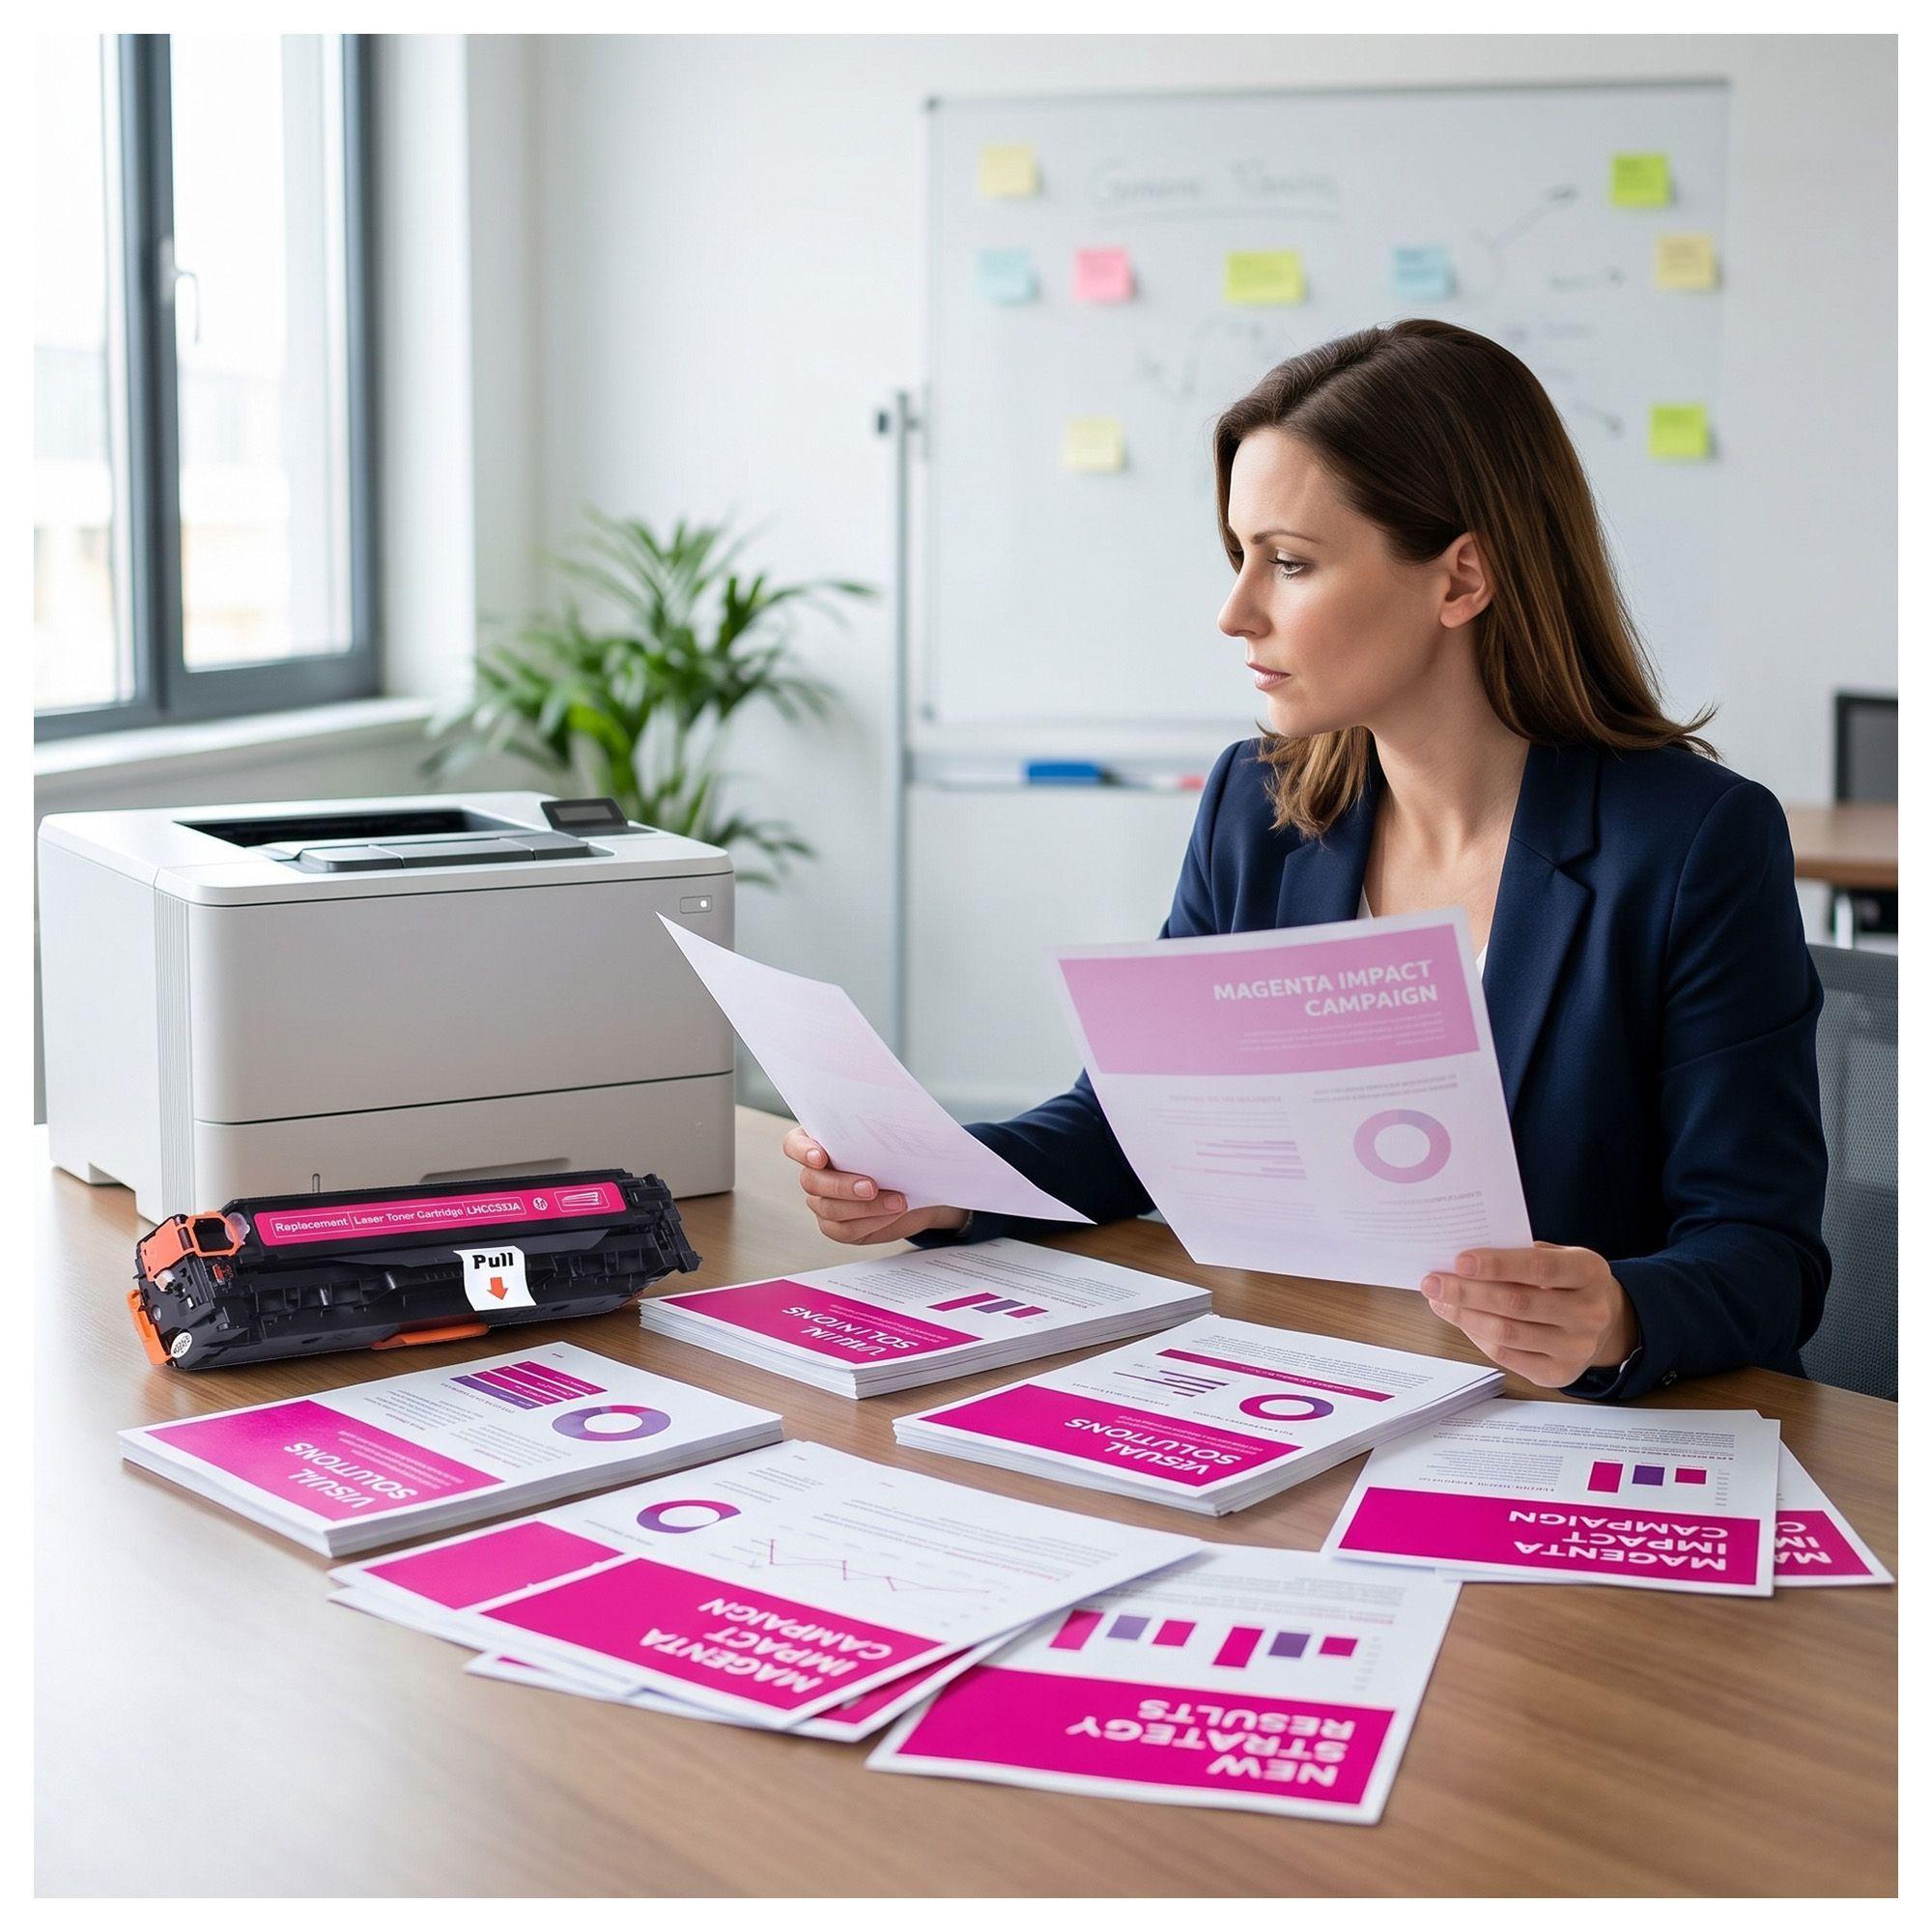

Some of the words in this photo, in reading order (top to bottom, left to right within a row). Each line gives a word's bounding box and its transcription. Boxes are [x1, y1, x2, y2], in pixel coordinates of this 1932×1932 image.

[1213, 974, 1333, 1000] MAGENTA
[1338, 959, 1432, 989] IMPACT
[1304, 984, 1437, 1016] CAMPAIGN
[274, 1217, 349, 1233] Replacement
[353, 1215, 384, 1226] Laser
[385, 1211, 414, 1222] Toner
[416, 1206, 464, 1220] Cartridge
[471, 1252, 514, 1269] Pull
[1065, 1418, 1241, 1464] SOLUTIONS
[283, 1442, 418, 1500] SOLUTIONS
[1509, 1510, 1728, 1539] CAMPAIGN
[1562, 1531, 1727, 1555] IMPACT
[1514, 1541, 1727, 1571] MAGENTA
[697, 1598, 893, 1660] CAMPAIGN
[639, 1628, 824, 1693] MAGENTA
[704, 1626, 858, 1677] IMPACT
[1067, 1716, 1348, 1764] STRATEGY
[1138, 1699, 1356, 1742] RESULTS
[1208, 1754, 1339, 1787] NEW
